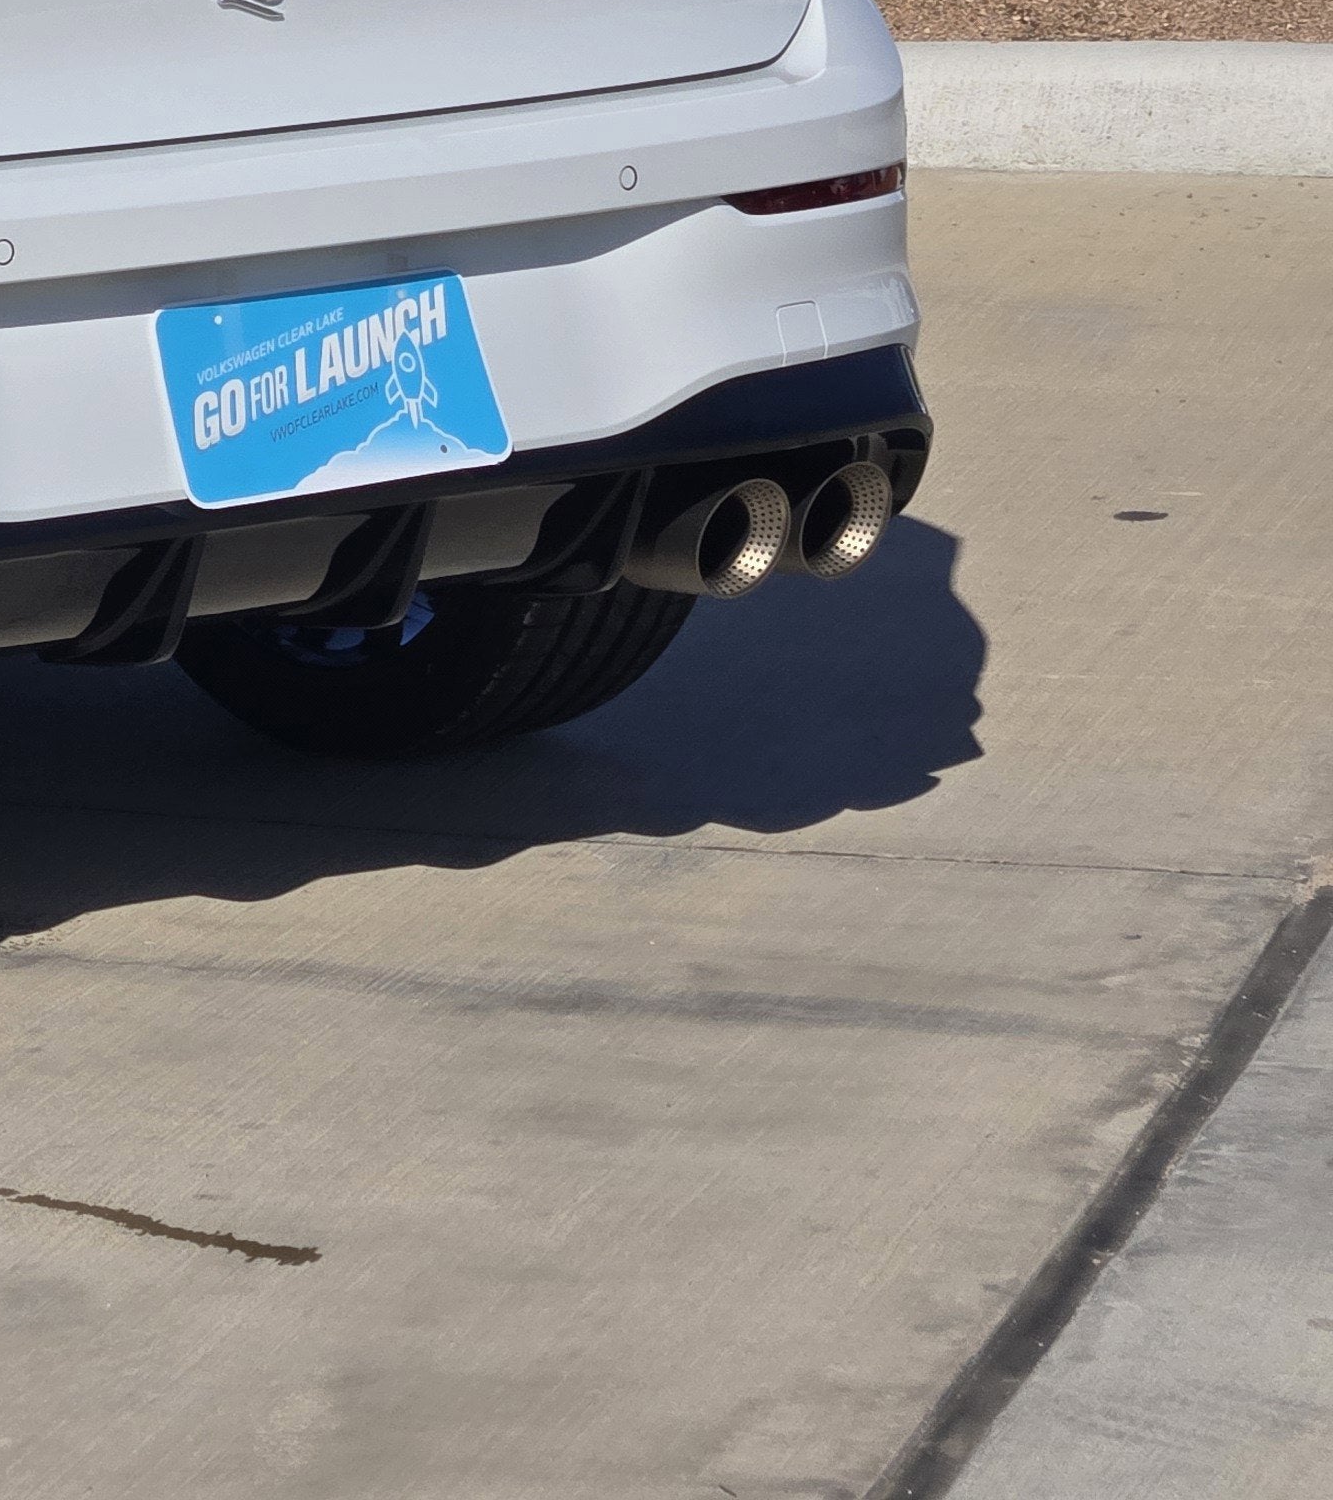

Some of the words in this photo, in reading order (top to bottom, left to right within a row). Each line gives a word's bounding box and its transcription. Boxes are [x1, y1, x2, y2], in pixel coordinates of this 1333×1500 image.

[194, 379, 246, 450] GO
[250, 365, 289, 421] FOR
[294, 283, 447, 404] LAUNCH
[196, 339, 275, 385] VOLKSWAGEN
[277, 320, 314, 348] CLEAR
[315, 306, 345, 336] LAKE
[270, 383, 380, 443] VWOFCLEARLAKE.COM
